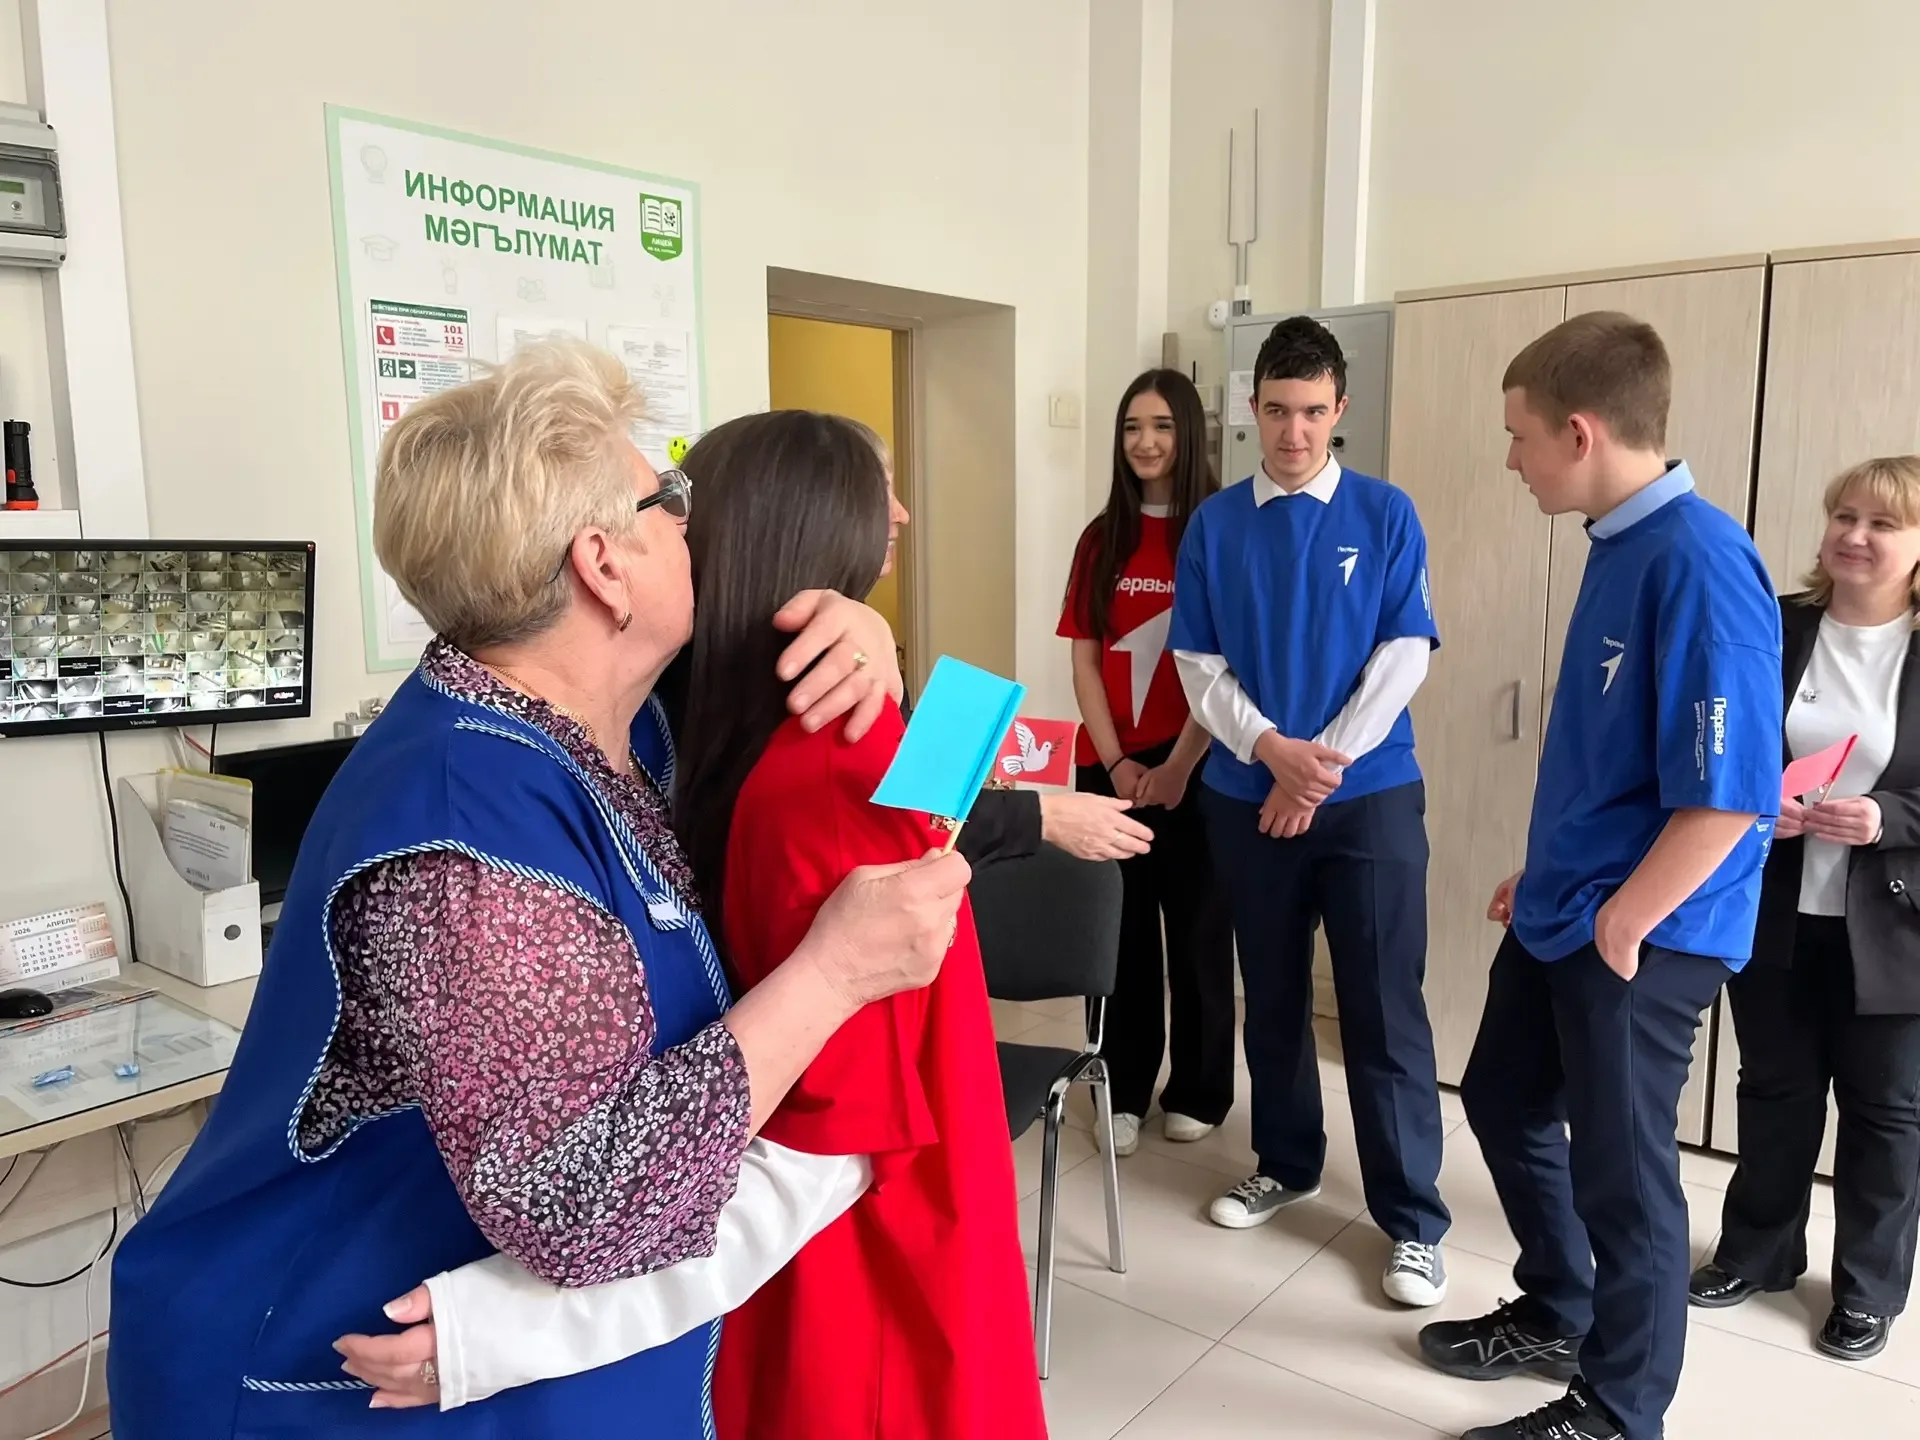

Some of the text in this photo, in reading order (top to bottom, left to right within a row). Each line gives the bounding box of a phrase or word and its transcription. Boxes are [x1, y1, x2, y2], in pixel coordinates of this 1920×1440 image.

[405, 169, 615, 232] ИНФОРМАЦИЯ
[444, 325, 463, 334] 101
[444, 336, 464, 346] 112
[1710, 697, 1727, 755] Первые
[14, 928, 31, 936] 2026
[46, 918, 76, 928] АПРЕЛЬ
